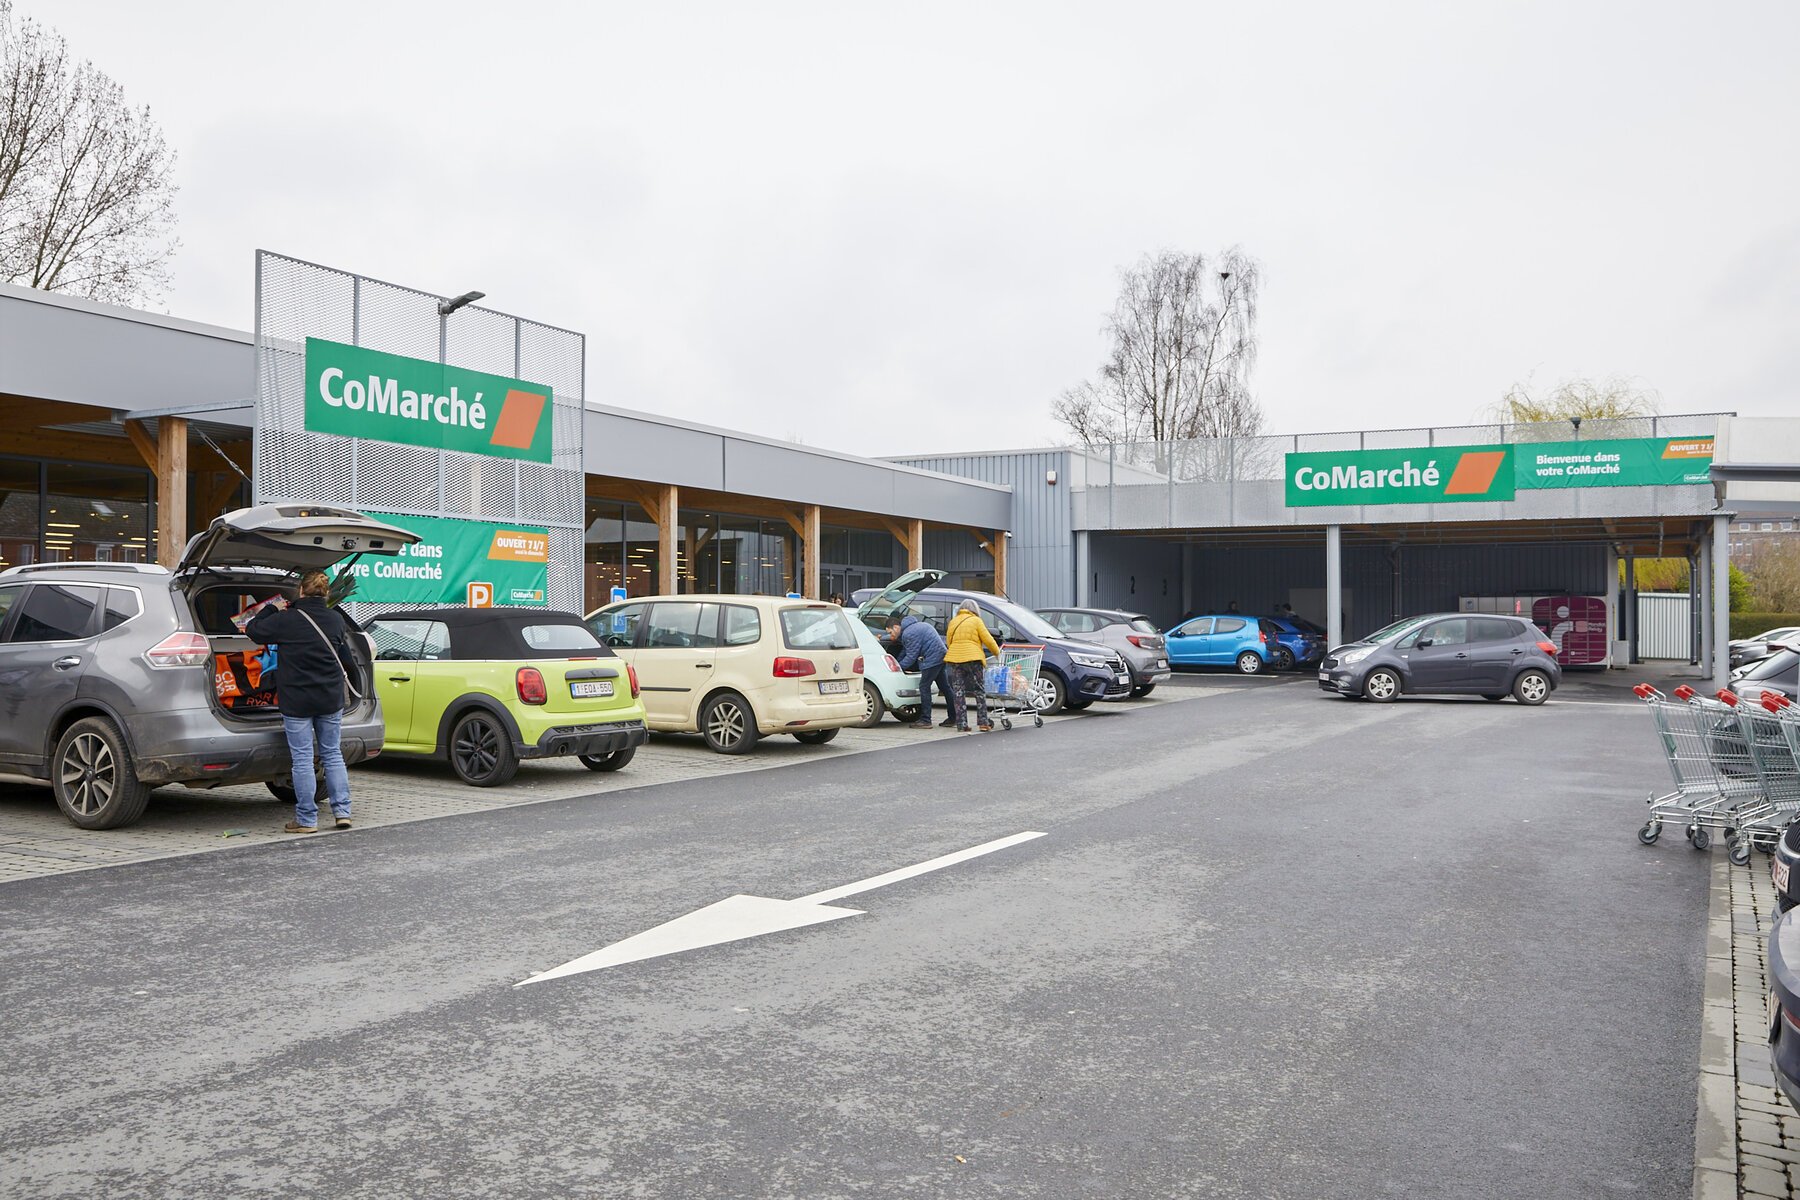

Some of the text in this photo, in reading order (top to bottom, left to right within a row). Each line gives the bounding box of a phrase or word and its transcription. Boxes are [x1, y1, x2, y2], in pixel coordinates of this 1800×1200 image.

[319, 367, 487, 430] CoMarché
[1536, 452, 1620, 465] Bienvenue dans
[1294, 460, 1440, 490] CoMarché
[1536, 464, 1620, 476] votre CoMarché
[410, 543, 442, 558] dans
[498, 538, 526, 549] OUVERT
[374, 561, 442, 580] CoMarché
[1094, 572, 1098, 592] 1
[1130, 576, 1135, 594] 2
[472, 586, 489, 608] P
